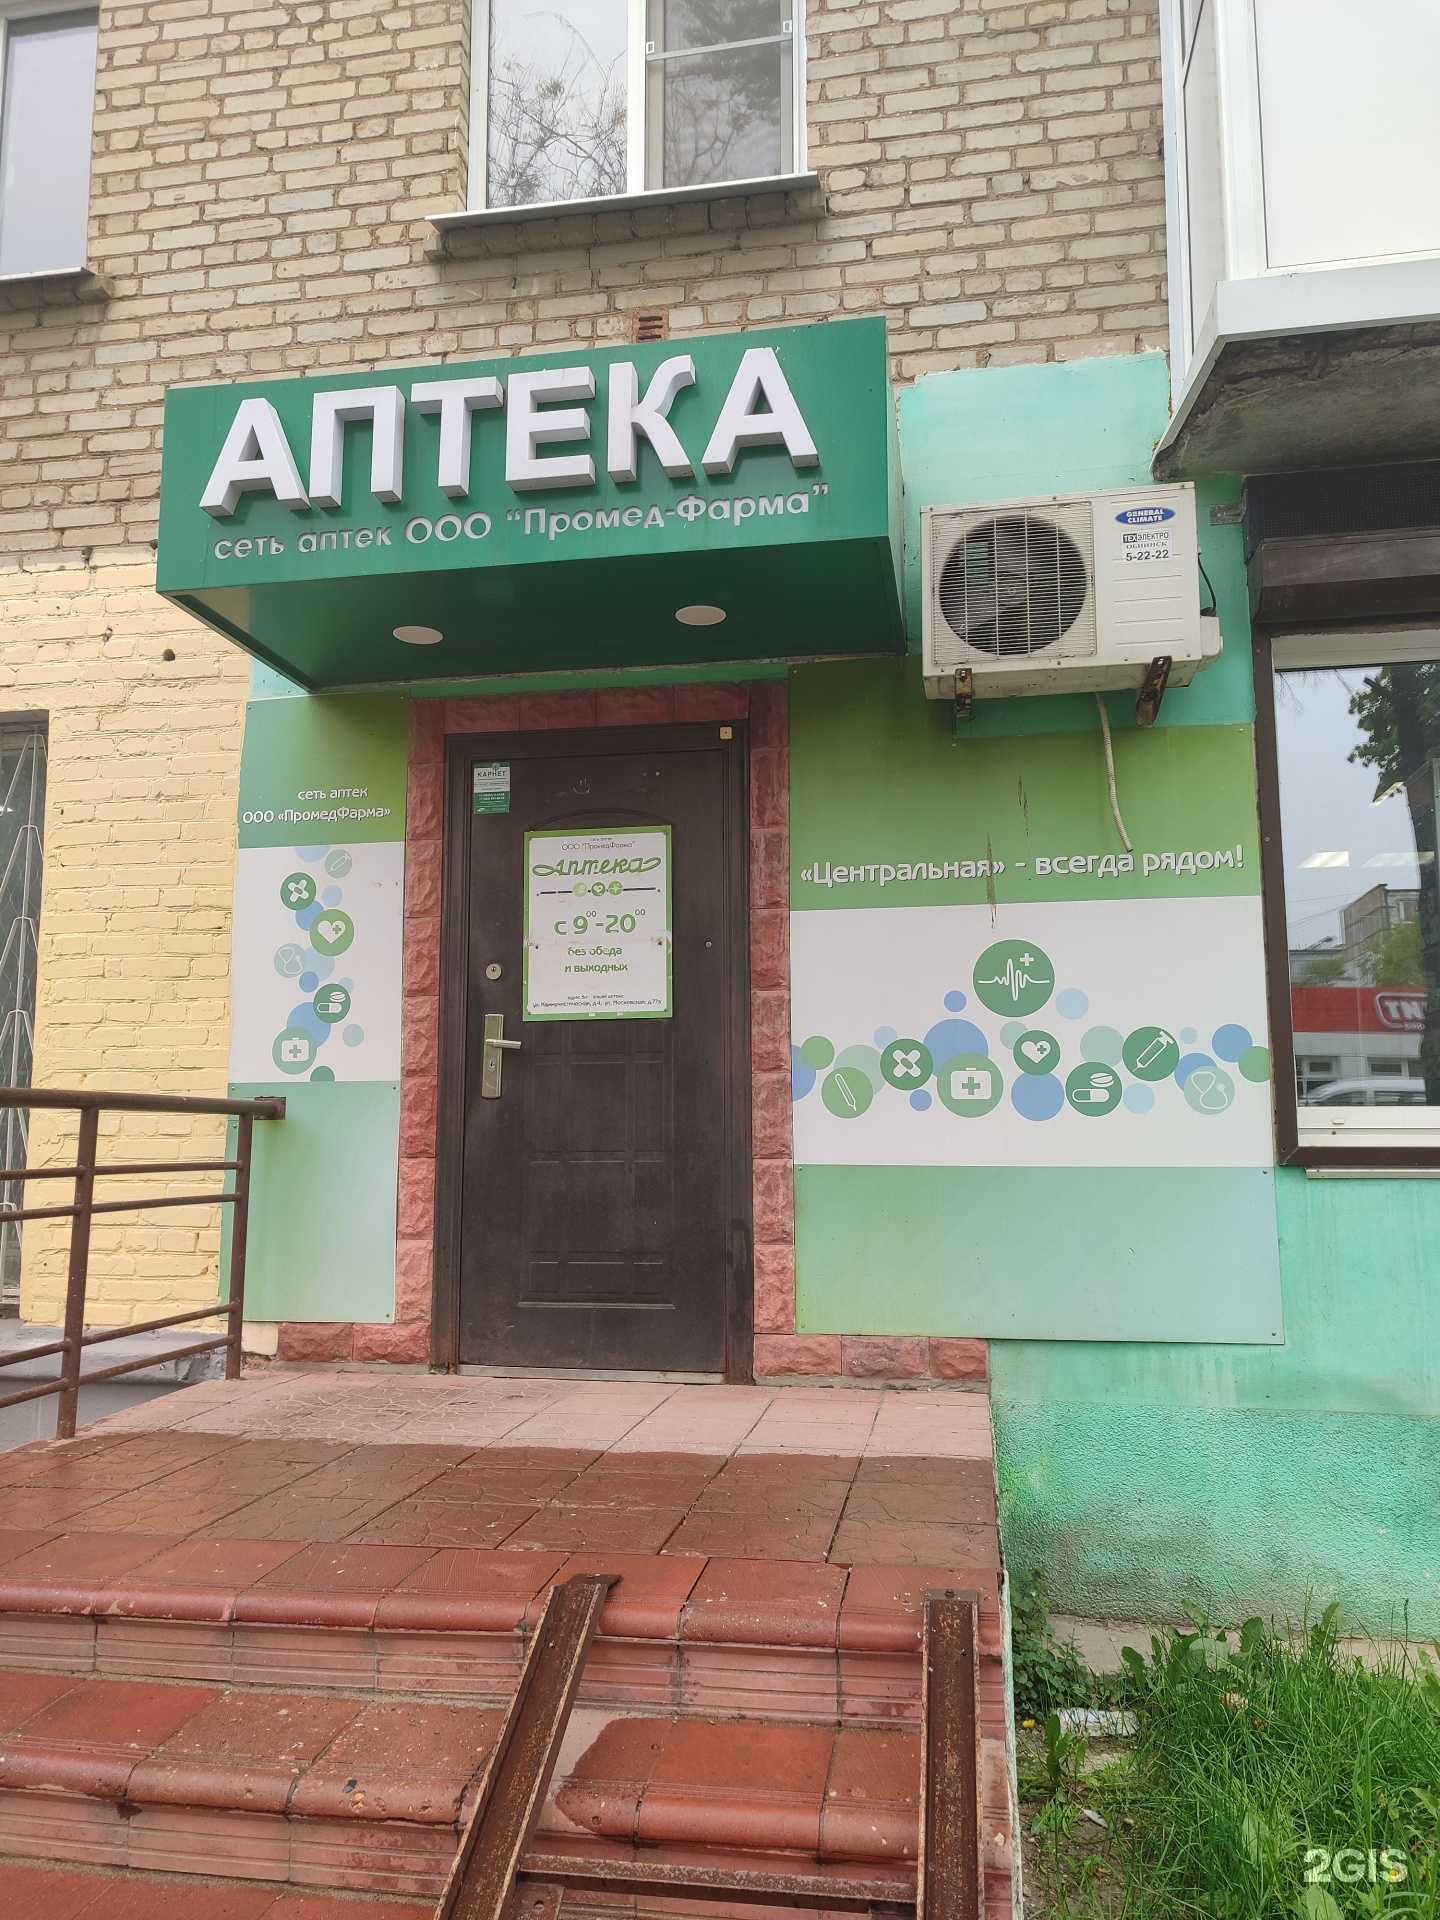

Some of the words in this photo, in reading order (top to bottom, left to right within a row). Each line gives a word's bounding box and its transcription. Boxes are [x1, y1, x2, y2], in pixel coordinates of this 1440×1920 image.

[200, 347, 820, 517] АПТЕКА
[1126, 509, 1164, 517] GENERAL
[1127, 515, 1163, 524] CLIMATE
[214, 535, 285, 560] сеть
[298, 526, 392, 553] аптек
[405, 512, 492, 544] ООО
[1126, 549, 1169, 561] 5-22-22
[297, 788, 327, 800] сеть
[330, 787, 368, 798] аптек
[242, 810, 274, 824] ООО
[278, 806, 391, 824] «ПромедФарма»
[800, 859, 1006, 888] «Центральная»
[1035, 852, 1135, 878] всегда
[1143, 844, 1244, 877] рядом!
[574, 963, 628, 973] выходных
